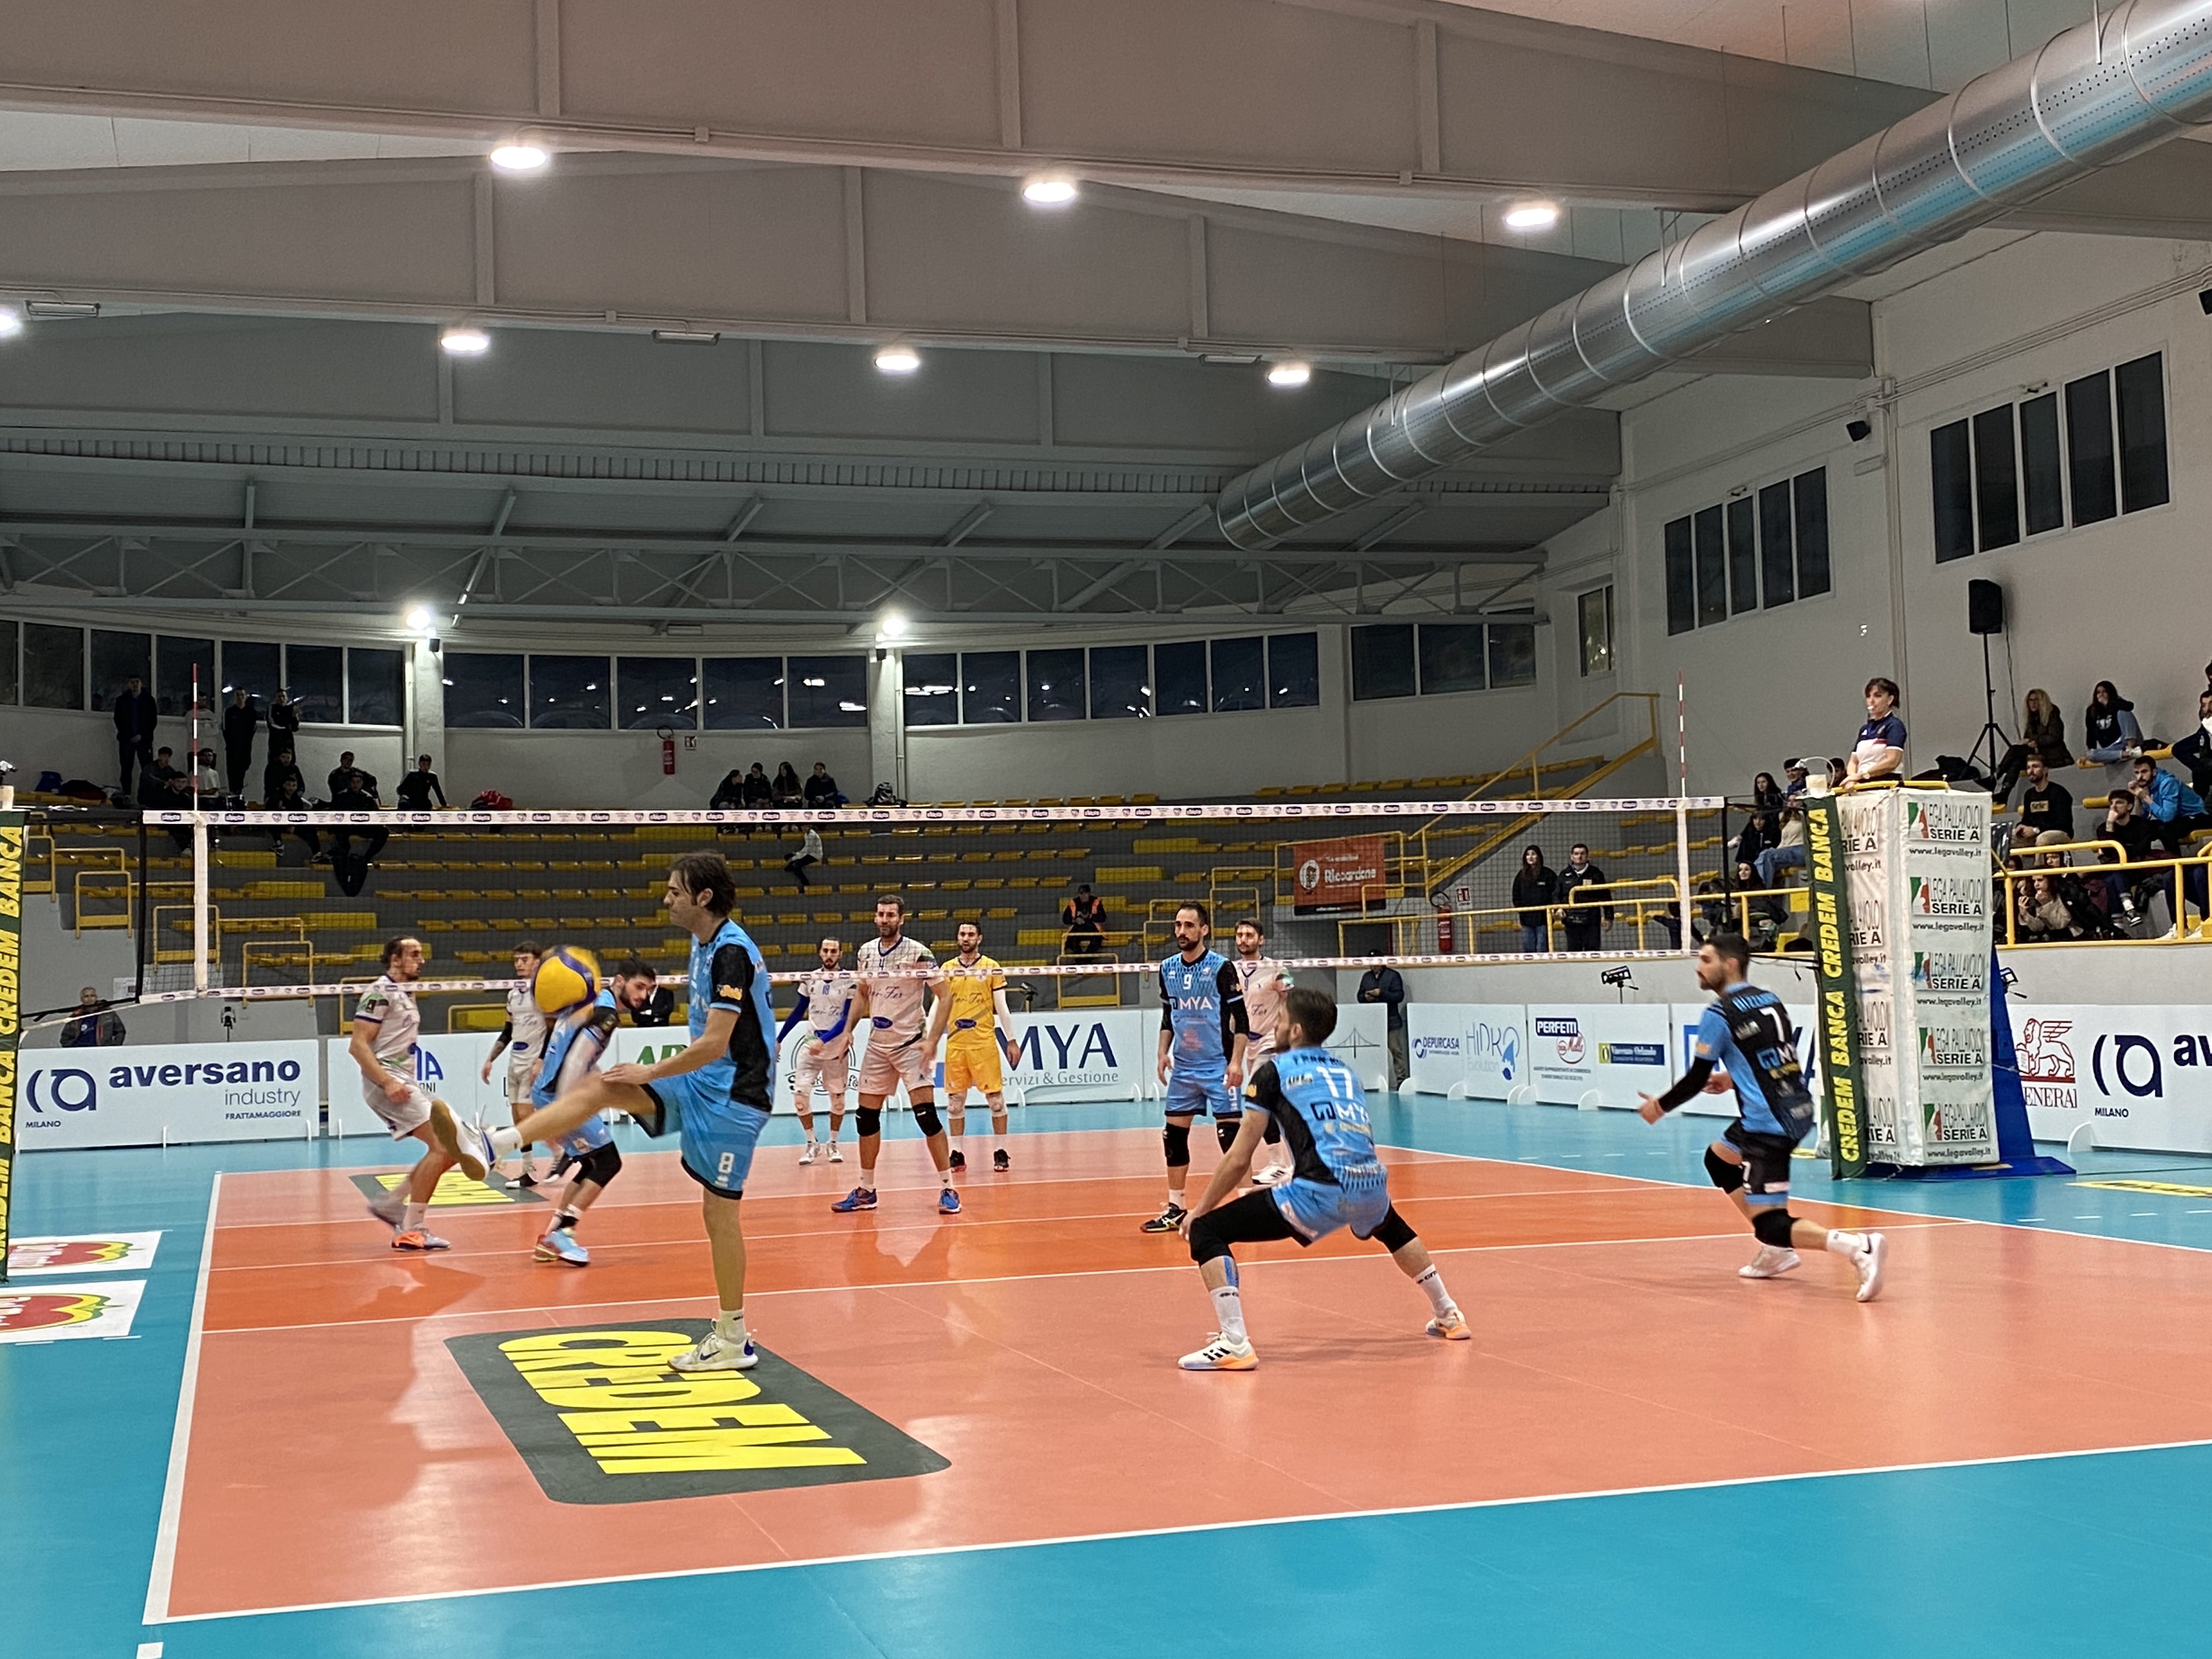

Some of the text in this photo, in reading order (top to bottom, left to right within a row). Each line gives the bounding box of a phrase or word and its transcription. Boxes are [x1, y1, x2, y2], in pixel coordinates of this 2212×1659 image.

[1930, 829, 1979, 840] SERIE A
[1865, 837, 1877, 851] A
[0, 826, 22, 918] BANCA
[1808, 808, 1842, 978] CREDEM BANCA
[1932, 903, 1982, 915] SERIE A
[1871, 930, 1882, 945] A
[1183, 974, 1193, 990] 9
[1932, 978, 1981, 990] SERIE A
[1179, 996, 1213, 1011] MYA
[1537, 1021, 1577, 1034] PERFETTI
[1758, 1006, 1785, 1042] 7
[1423, 1036, 1460, 1049] DEPURCASA
[1878, 1031, 1888, 1045] A
[995, 1023, 1118, 1071] MYA
[1936, 1053, 1983, 1064] SERIE A
[109, 1060, 301, 1088] aversano
[1001, 1070, 1118, 1086] ervizi & Gestione
[1826, 990, 1860, 1163] CREDEM BANCA
[1316, 1066, 1354, 1100] 17
[225, 1088, 301, 1107] industry
[225, 1110, 301, 1120] FRATTAMAGGIORE
[2095, 1108, 2129, 1118] MILANO
[26, 1120, 61, 1128] MILANO
[1885, 1128, 1895, 1142] A
[1944, 1128, 1988, 1141] SERIE A
[718, 1152, 735, 1174] 8
[498, 1330, 868, 1475] CREDEM
